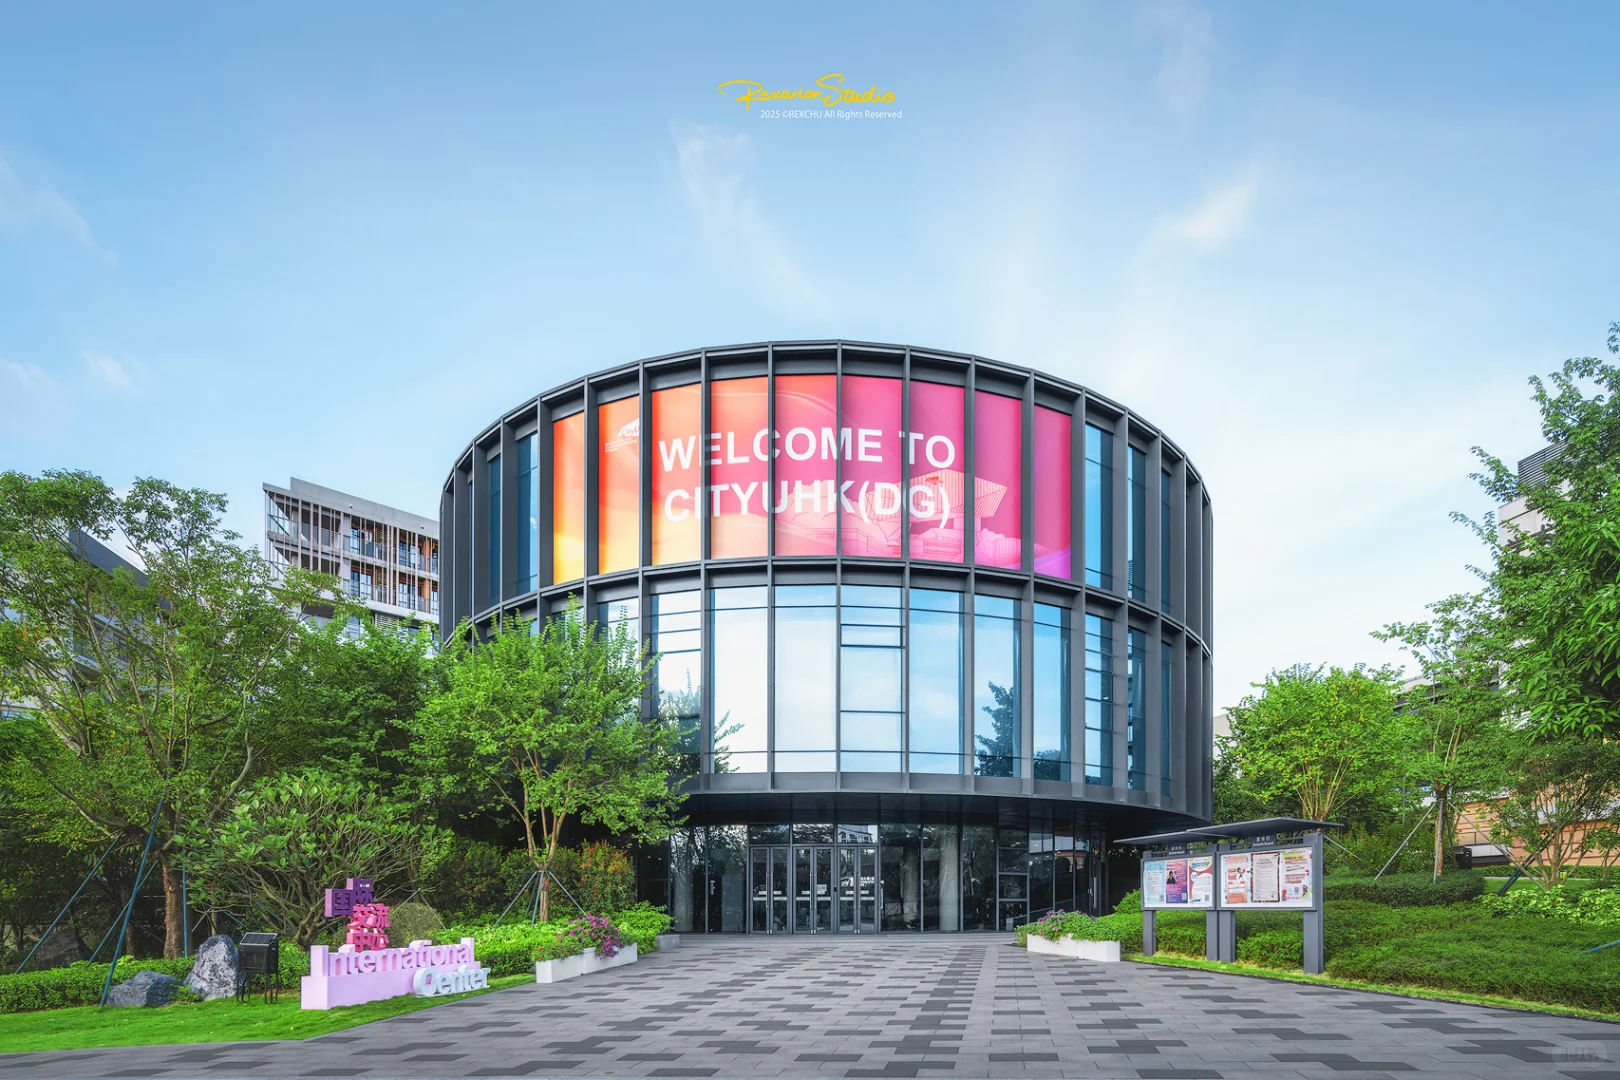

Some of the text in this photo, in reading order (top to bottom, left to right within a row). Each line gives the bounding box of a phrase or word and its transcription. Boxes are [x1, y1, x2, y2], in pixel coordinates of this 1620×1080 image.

[658, 427, 956, 472] WELCOME TO
[664, 479, 950, 529] CITYUHK(DG)
[311, 937, 475, 976] International
[413, 965, 491, 997] Center
